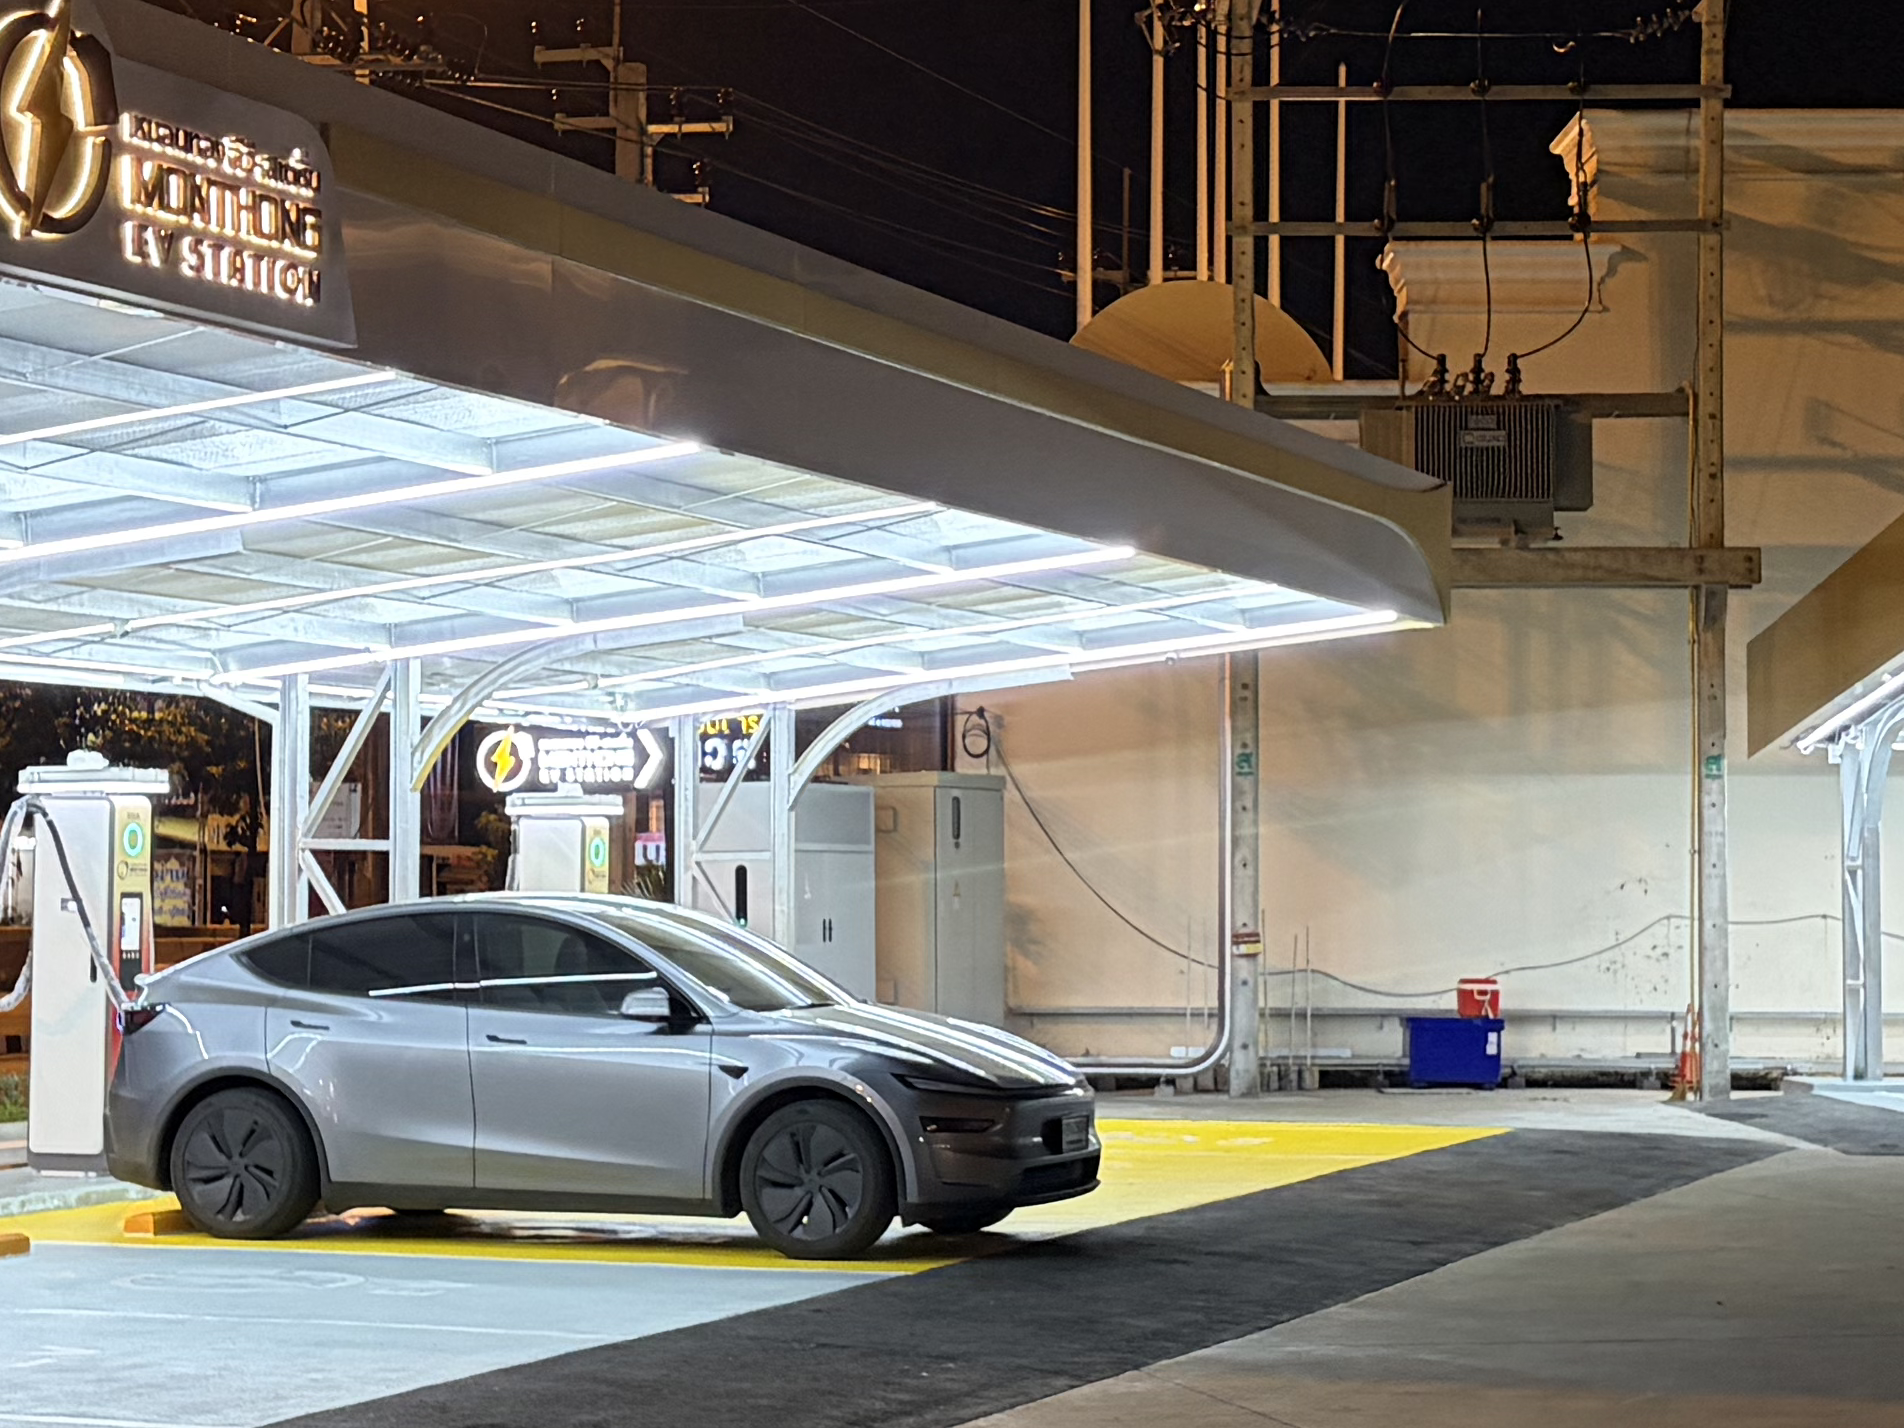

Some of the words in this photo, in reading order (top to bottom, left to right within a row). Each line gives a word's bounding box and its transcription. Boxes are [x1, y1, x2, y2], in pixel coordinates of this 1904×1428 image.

[121, 155, 322, 258] MONTHONG
[122, 221, 174, 267] EV
[181, 236, 321, 307] STATION
